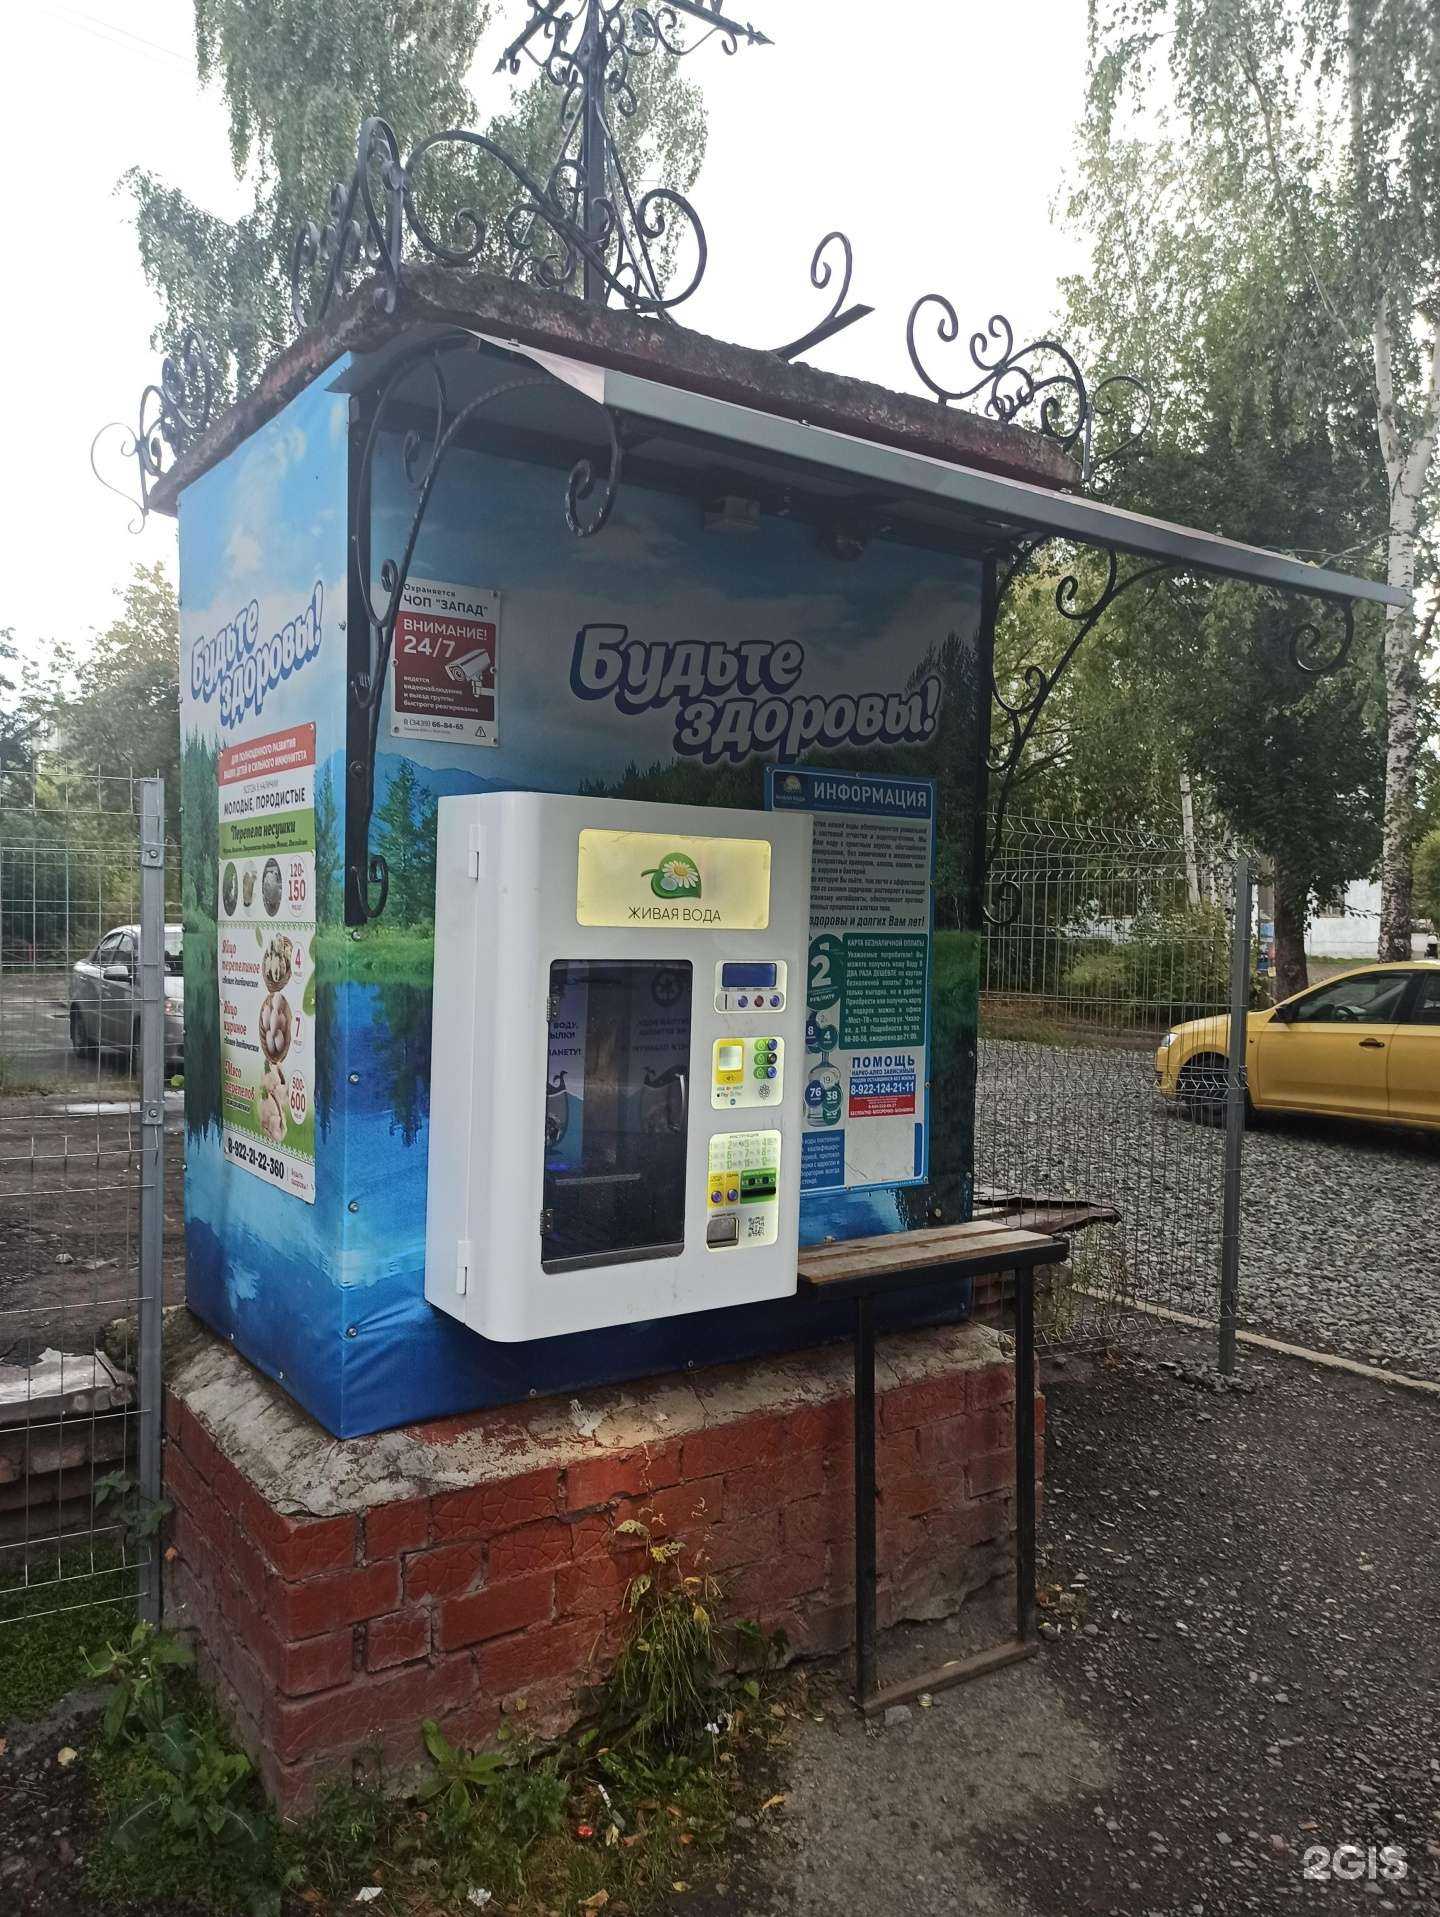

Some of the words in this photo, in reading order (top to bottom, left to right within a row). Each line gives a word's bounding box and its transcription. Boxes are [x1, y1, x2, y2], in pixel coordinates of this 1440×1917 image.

[403, 583, 456, 598] Охраняется
[403, 594, 432, 608] ЧОП
[435, 598, 488, 617] "ЗАПАД"
[403, 618, 488, 642] ВНИМАНИЕ!
[191, 598, 259, 703] Будьте
[219, 579, 323, 730] здоровы!
[403, 634, 456, 659] 24/7
[570, 622, 804, 716] Будьте
[403, 699, 435, 710] быстрого
[673, 674, 942, 766] здоровы!
[224, 797, 256, 816] МОЛОДЫЕ,
[255, 787, 306, 809] ПОРОДИСТЫЕ
[813, 781, 928, 810] ИНФОРМАЦИЯ
[230, 824, 262, 844] Перепела
[262, 821, 296, 840] несушки
[290, 863, 304, 878] 120-
[288, 879, 306, 902] 150
[628, 905, 679, 921] ЖИВАЯ
[682, 907, 722, 924] ВОДА
[809, 916, 848, 929] здоровы
[849, 917, 856, 926] и
[857, 917, 887, 928] долгих
[887, 915, 907, 927] Вам
[907, 915, 925, 928] лет!
[847, 939, 864, 947] КАРТА
[863, 938, 903, 948] БЕЗНАЛИЧНОЙ
[903, 939, 925, 947] ОПЛАТЫ
[295, 948, 303, 969] 4
[847, 950, 878, 959] Уважаемые
[811, 954, 832, 988] 2
[846, 969, 858, 979] ДВА
[295, 1016, 302, 1038] 7
[807, 1025, 814, 1036] 8
[824, 1030, 831, 1039] 4
[224, 1060, 242, 1079] Мясо
[852, 1054, 915, 1069] ПОМОЩЬ
[851, 1069, 883, 1077] НАРКО-АЛКО
[883, 1067, 916, 1075] ЗАВИСИМЫМ
[809, 1087, 822, 1098] 76
[826, 1090, 838, 1101] 38
[850, 1082, 914, 1095] 8-922-124-21-11
[290, 1093, 306, 1113] 600
[227, 1137, 285, 1180] 8-922-21-22-360
